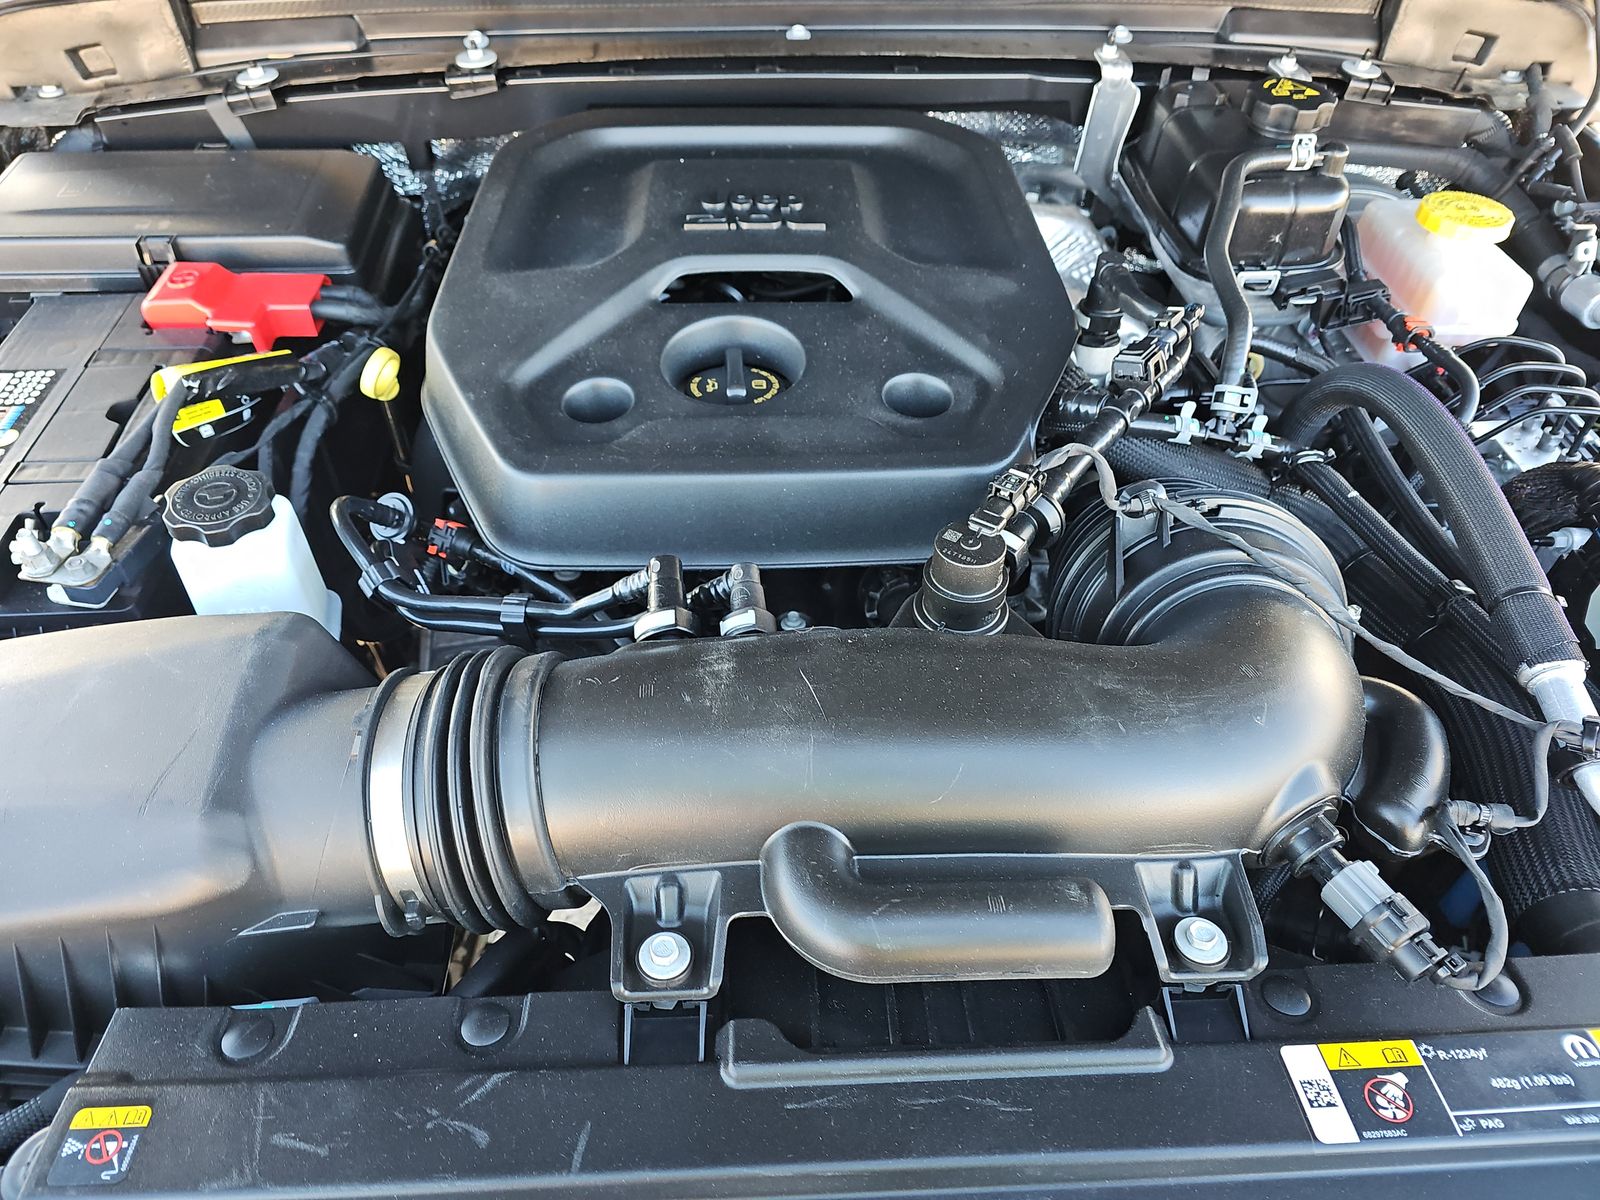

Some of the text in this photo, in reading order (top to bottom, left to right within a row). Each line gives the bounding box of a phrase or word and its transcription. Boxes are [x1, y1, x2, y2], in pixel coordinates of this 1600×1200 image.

[701, 193, 804, 214] Jeep
[180, 500, 250, 521] USE APPROVED
[1436, 1047, 1489, 1061] R-1234yf
[1490, 1072, 1576, 1090] 482g (1.06 lbs)
[1478, 1117, 1505, 1130] PAG
